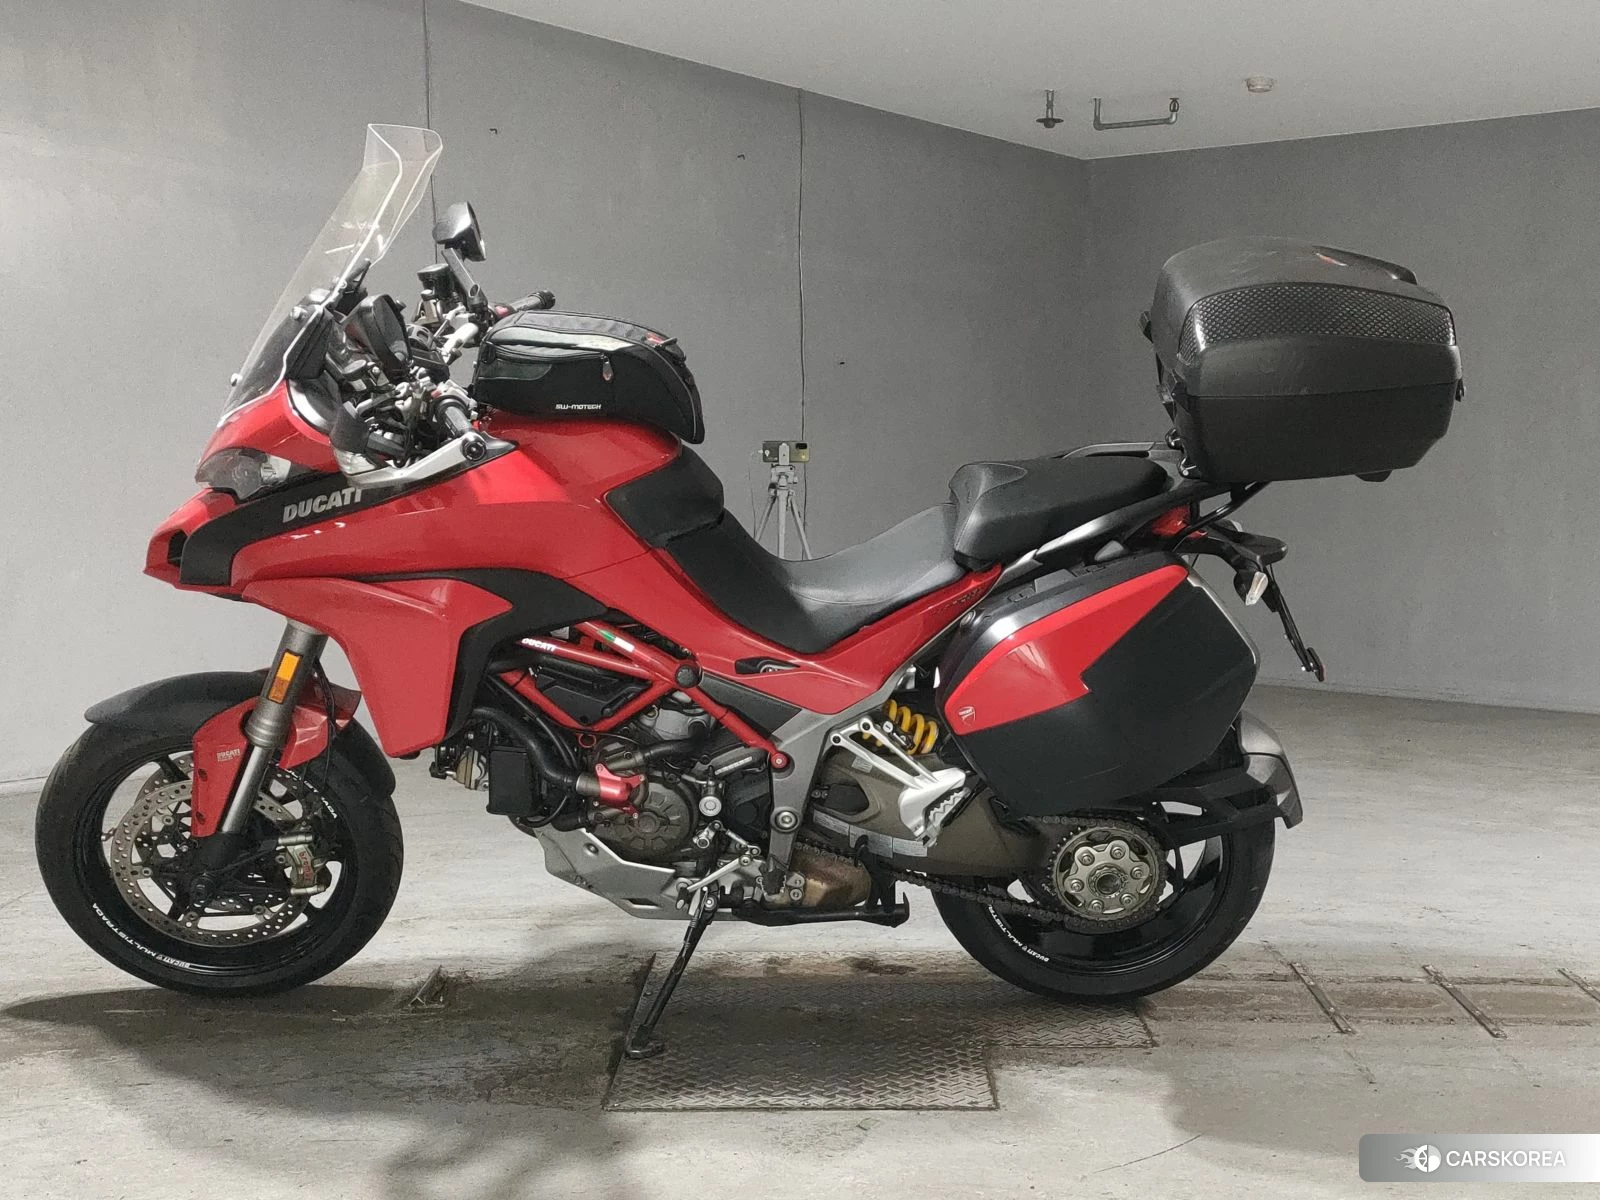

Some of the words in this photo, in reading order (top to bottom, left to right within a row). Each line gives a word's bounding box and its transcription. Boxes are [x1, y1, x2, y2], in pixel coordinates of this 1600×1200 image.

[282, 487, 364, 523] DUCATI
[521, 637, 558, 653] DUCATI
[92, 902, 157, 957] MULTISTRADA
[162, 956, 191, 969] DUCATI
[1026, 948, 1050, 963] DUCATI
